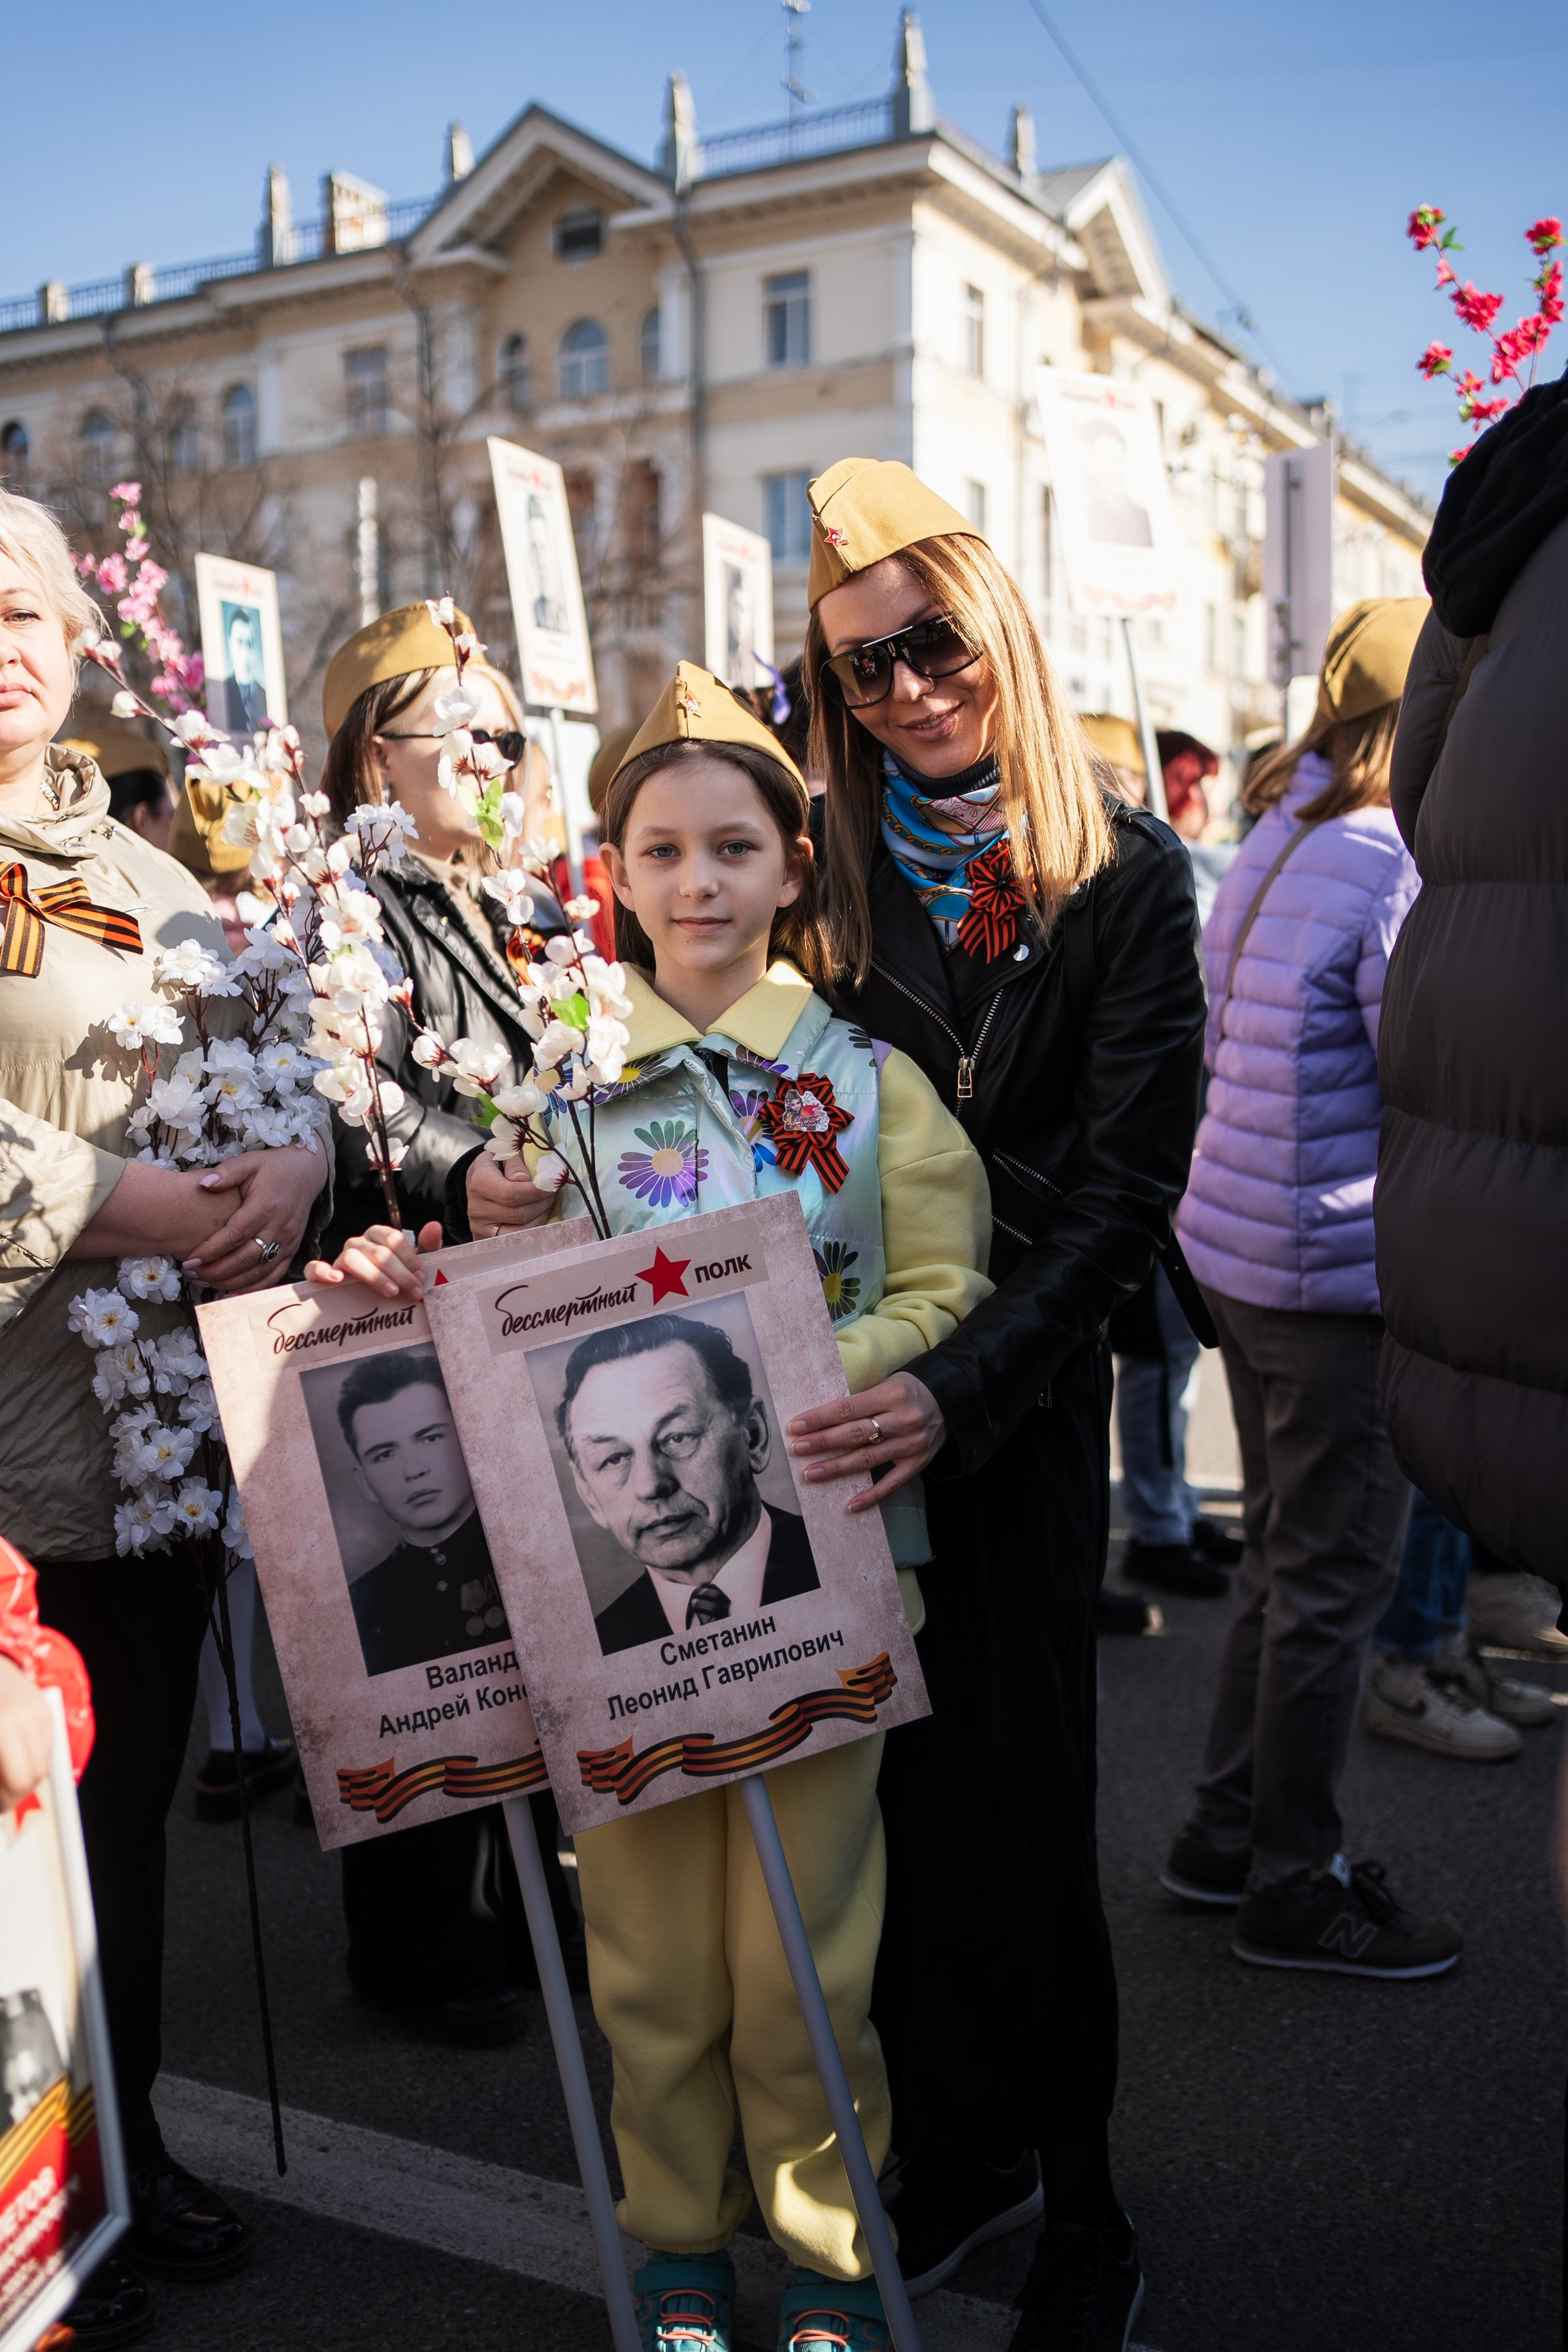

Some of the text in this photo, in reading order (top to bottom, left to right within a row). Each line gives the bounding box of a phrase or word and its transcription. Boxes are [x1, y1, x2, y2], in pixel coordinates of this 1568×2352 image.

[660, 1616, 777, 1665] Сметанин
[607, 1629, 845, 1721] Леонид Гаврилович
[379, 1693, 470, 1739] Андрей
